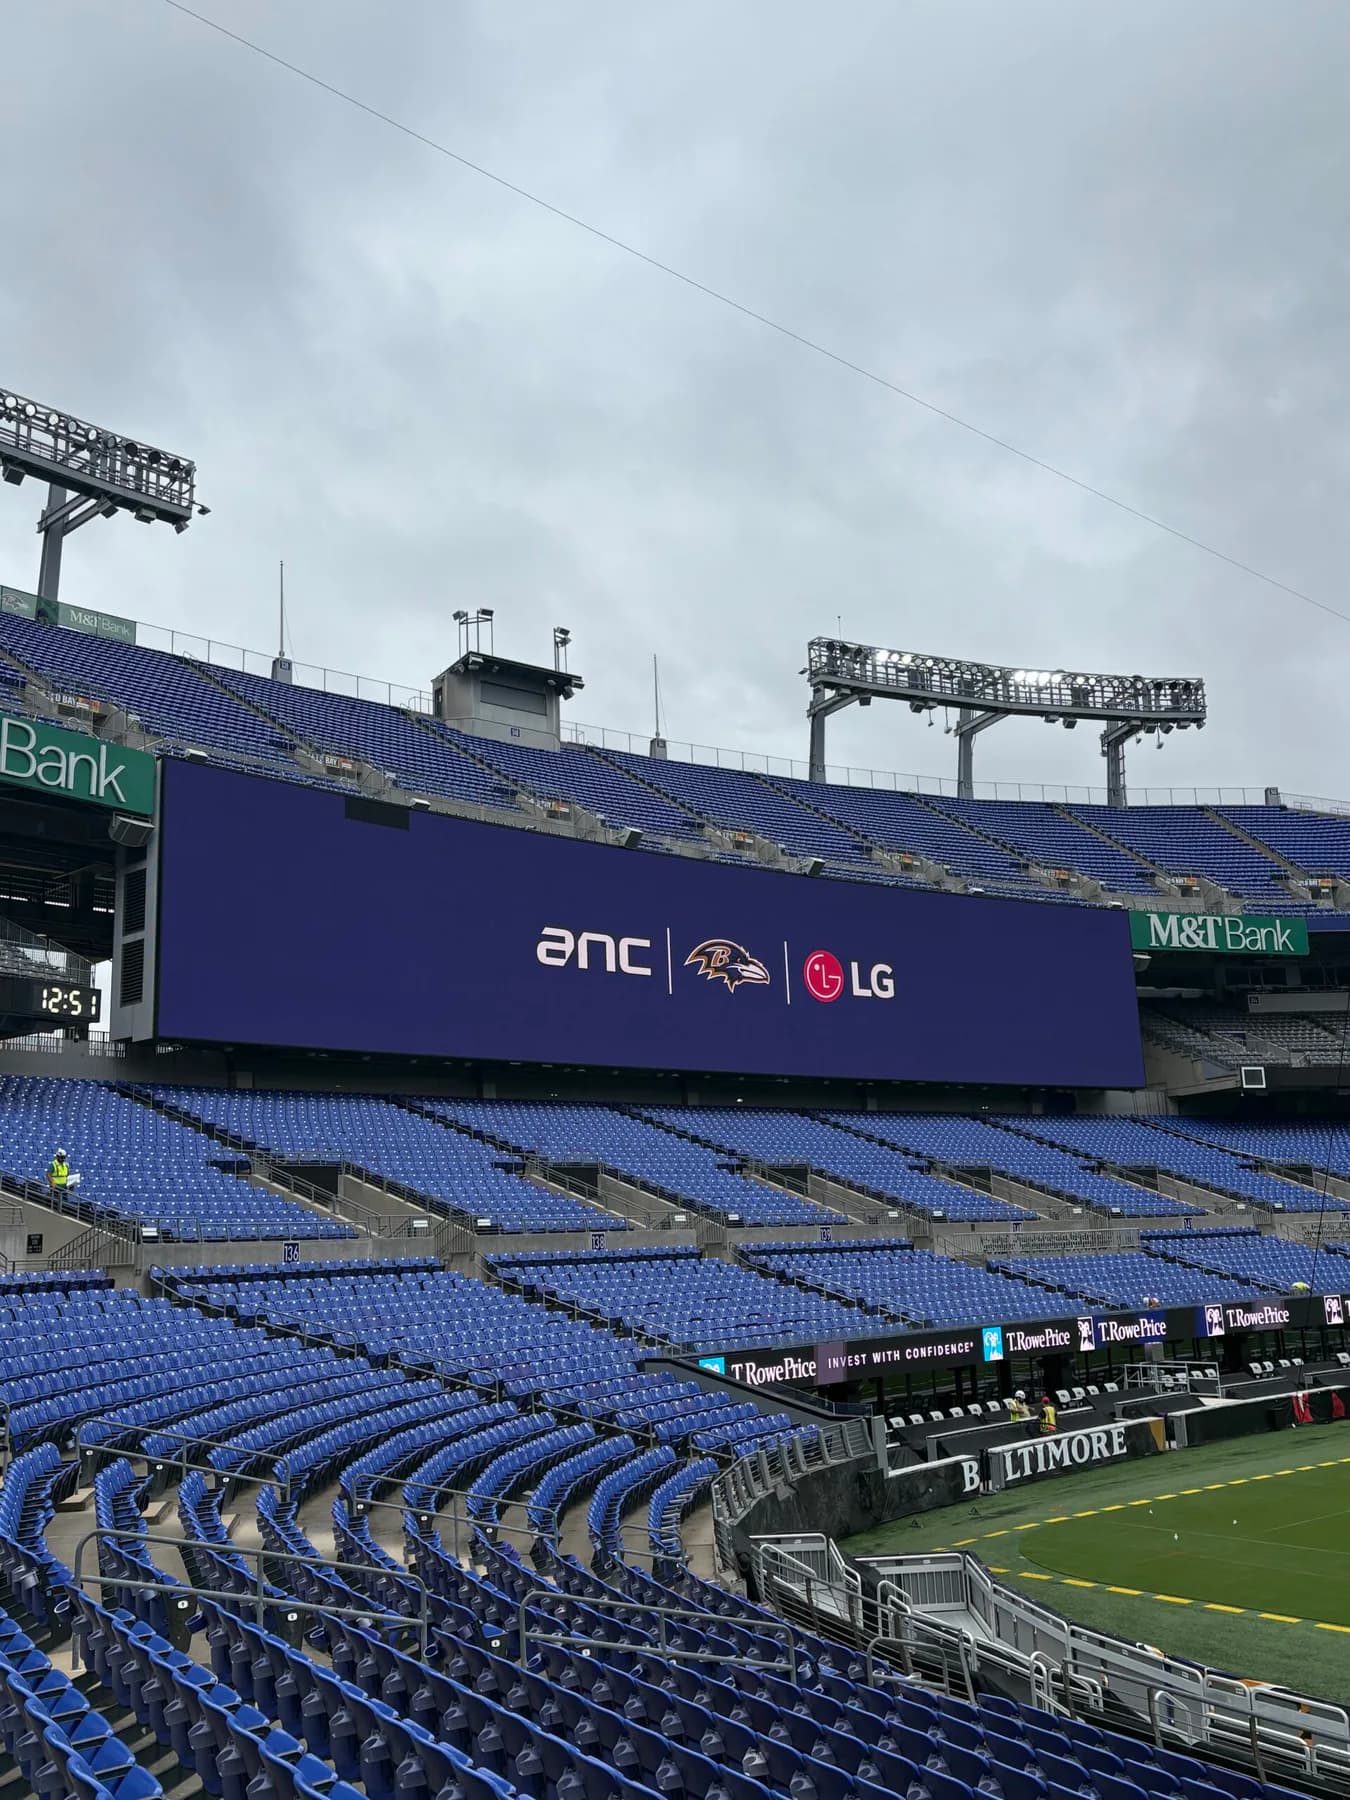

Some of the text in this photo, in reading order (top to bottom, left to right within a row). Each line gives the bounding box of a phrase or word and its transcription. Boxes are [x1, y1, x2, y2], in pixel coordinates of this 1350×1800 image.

[102, 620, 130, 637] Bank
[1, 718, 126, 803] Bank
[1146, 914, 1294, 951] M&T Bank
[537, 926, 651, 976] anc
[851, 961, 895, 999] LG
[42, 988, 97, 1015] 12:51
[284, 1244, 299, 1262] 136
[828, 1353, 867, 1369] INVEST
[872, 1350, 900, 1364] WITH
